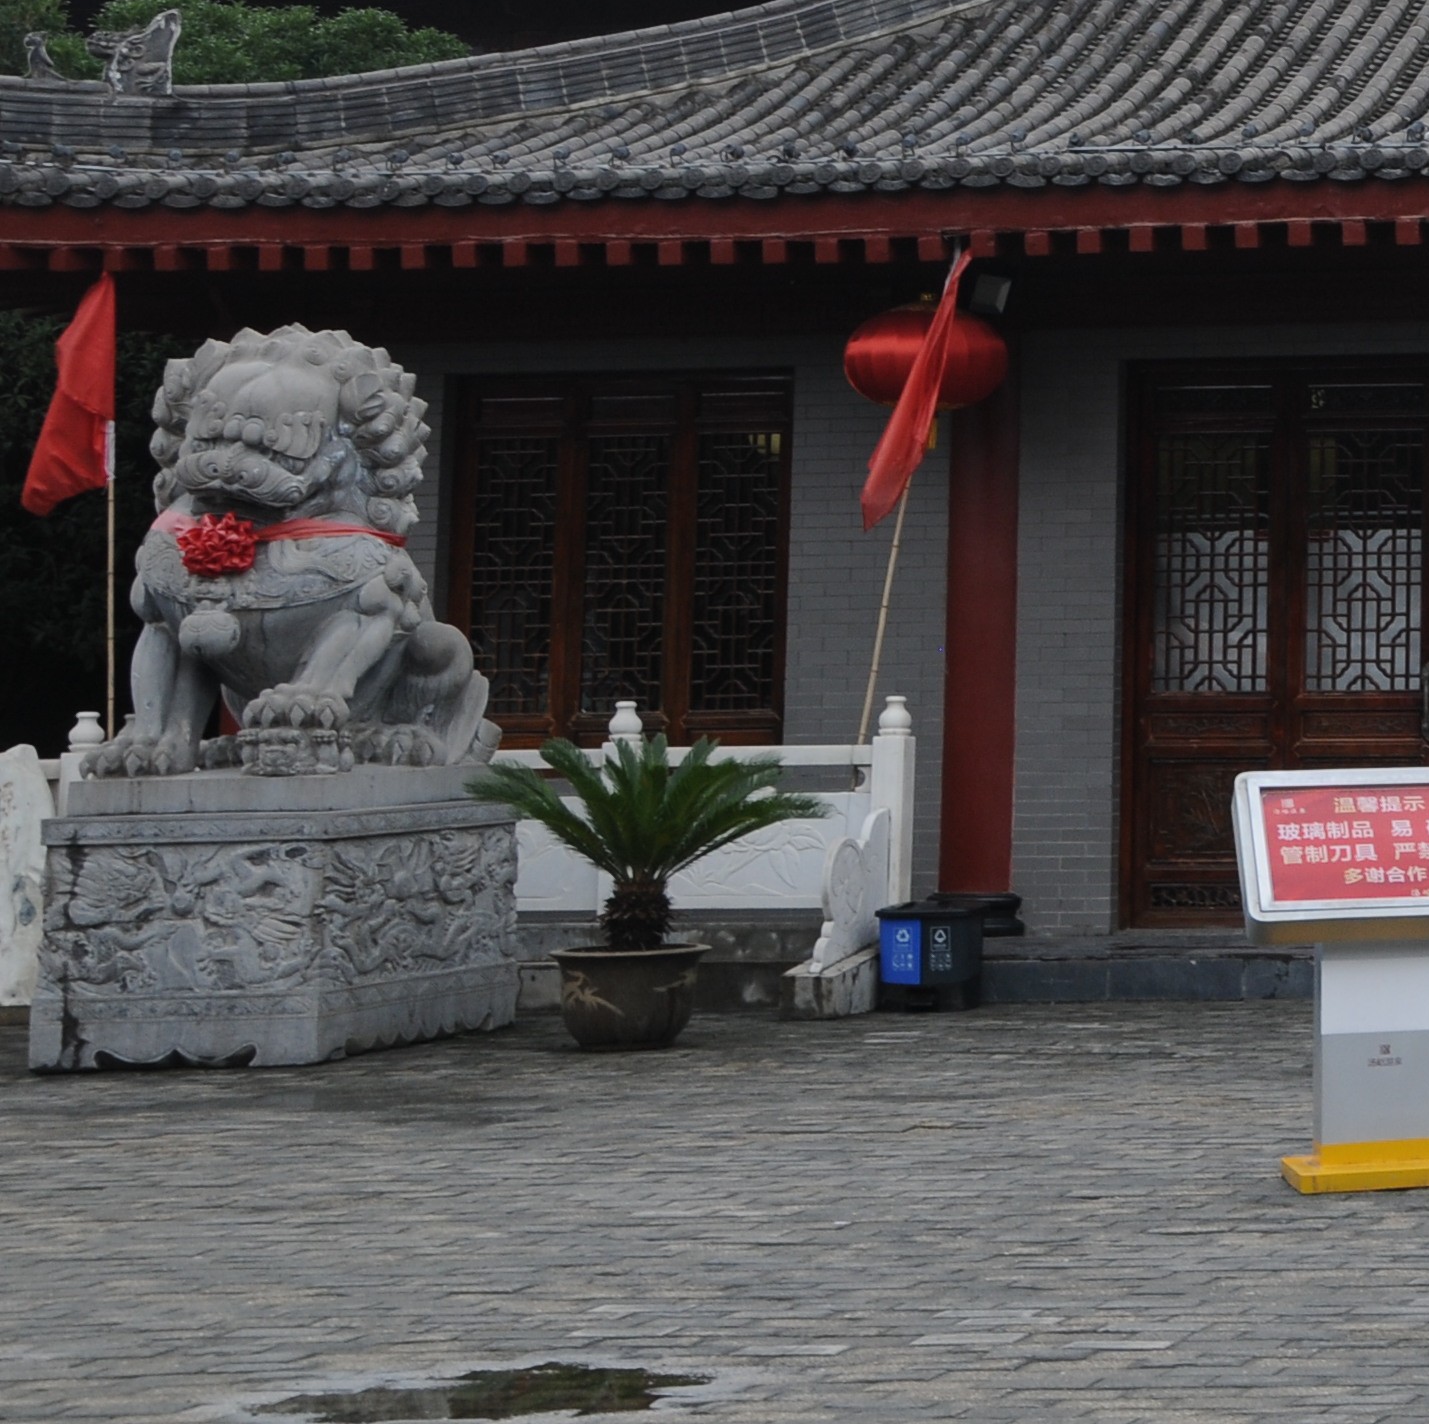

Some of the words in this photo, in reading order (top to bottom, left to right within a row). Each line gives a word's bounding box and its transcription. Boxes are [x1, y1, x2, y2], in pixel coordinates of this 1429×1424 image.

[1333, 795, 1426, 814] 温馨提示
[1276, 820, 1375, 842] 玻璃制品
[1279, 842, 1378, 865] 管制刀具
